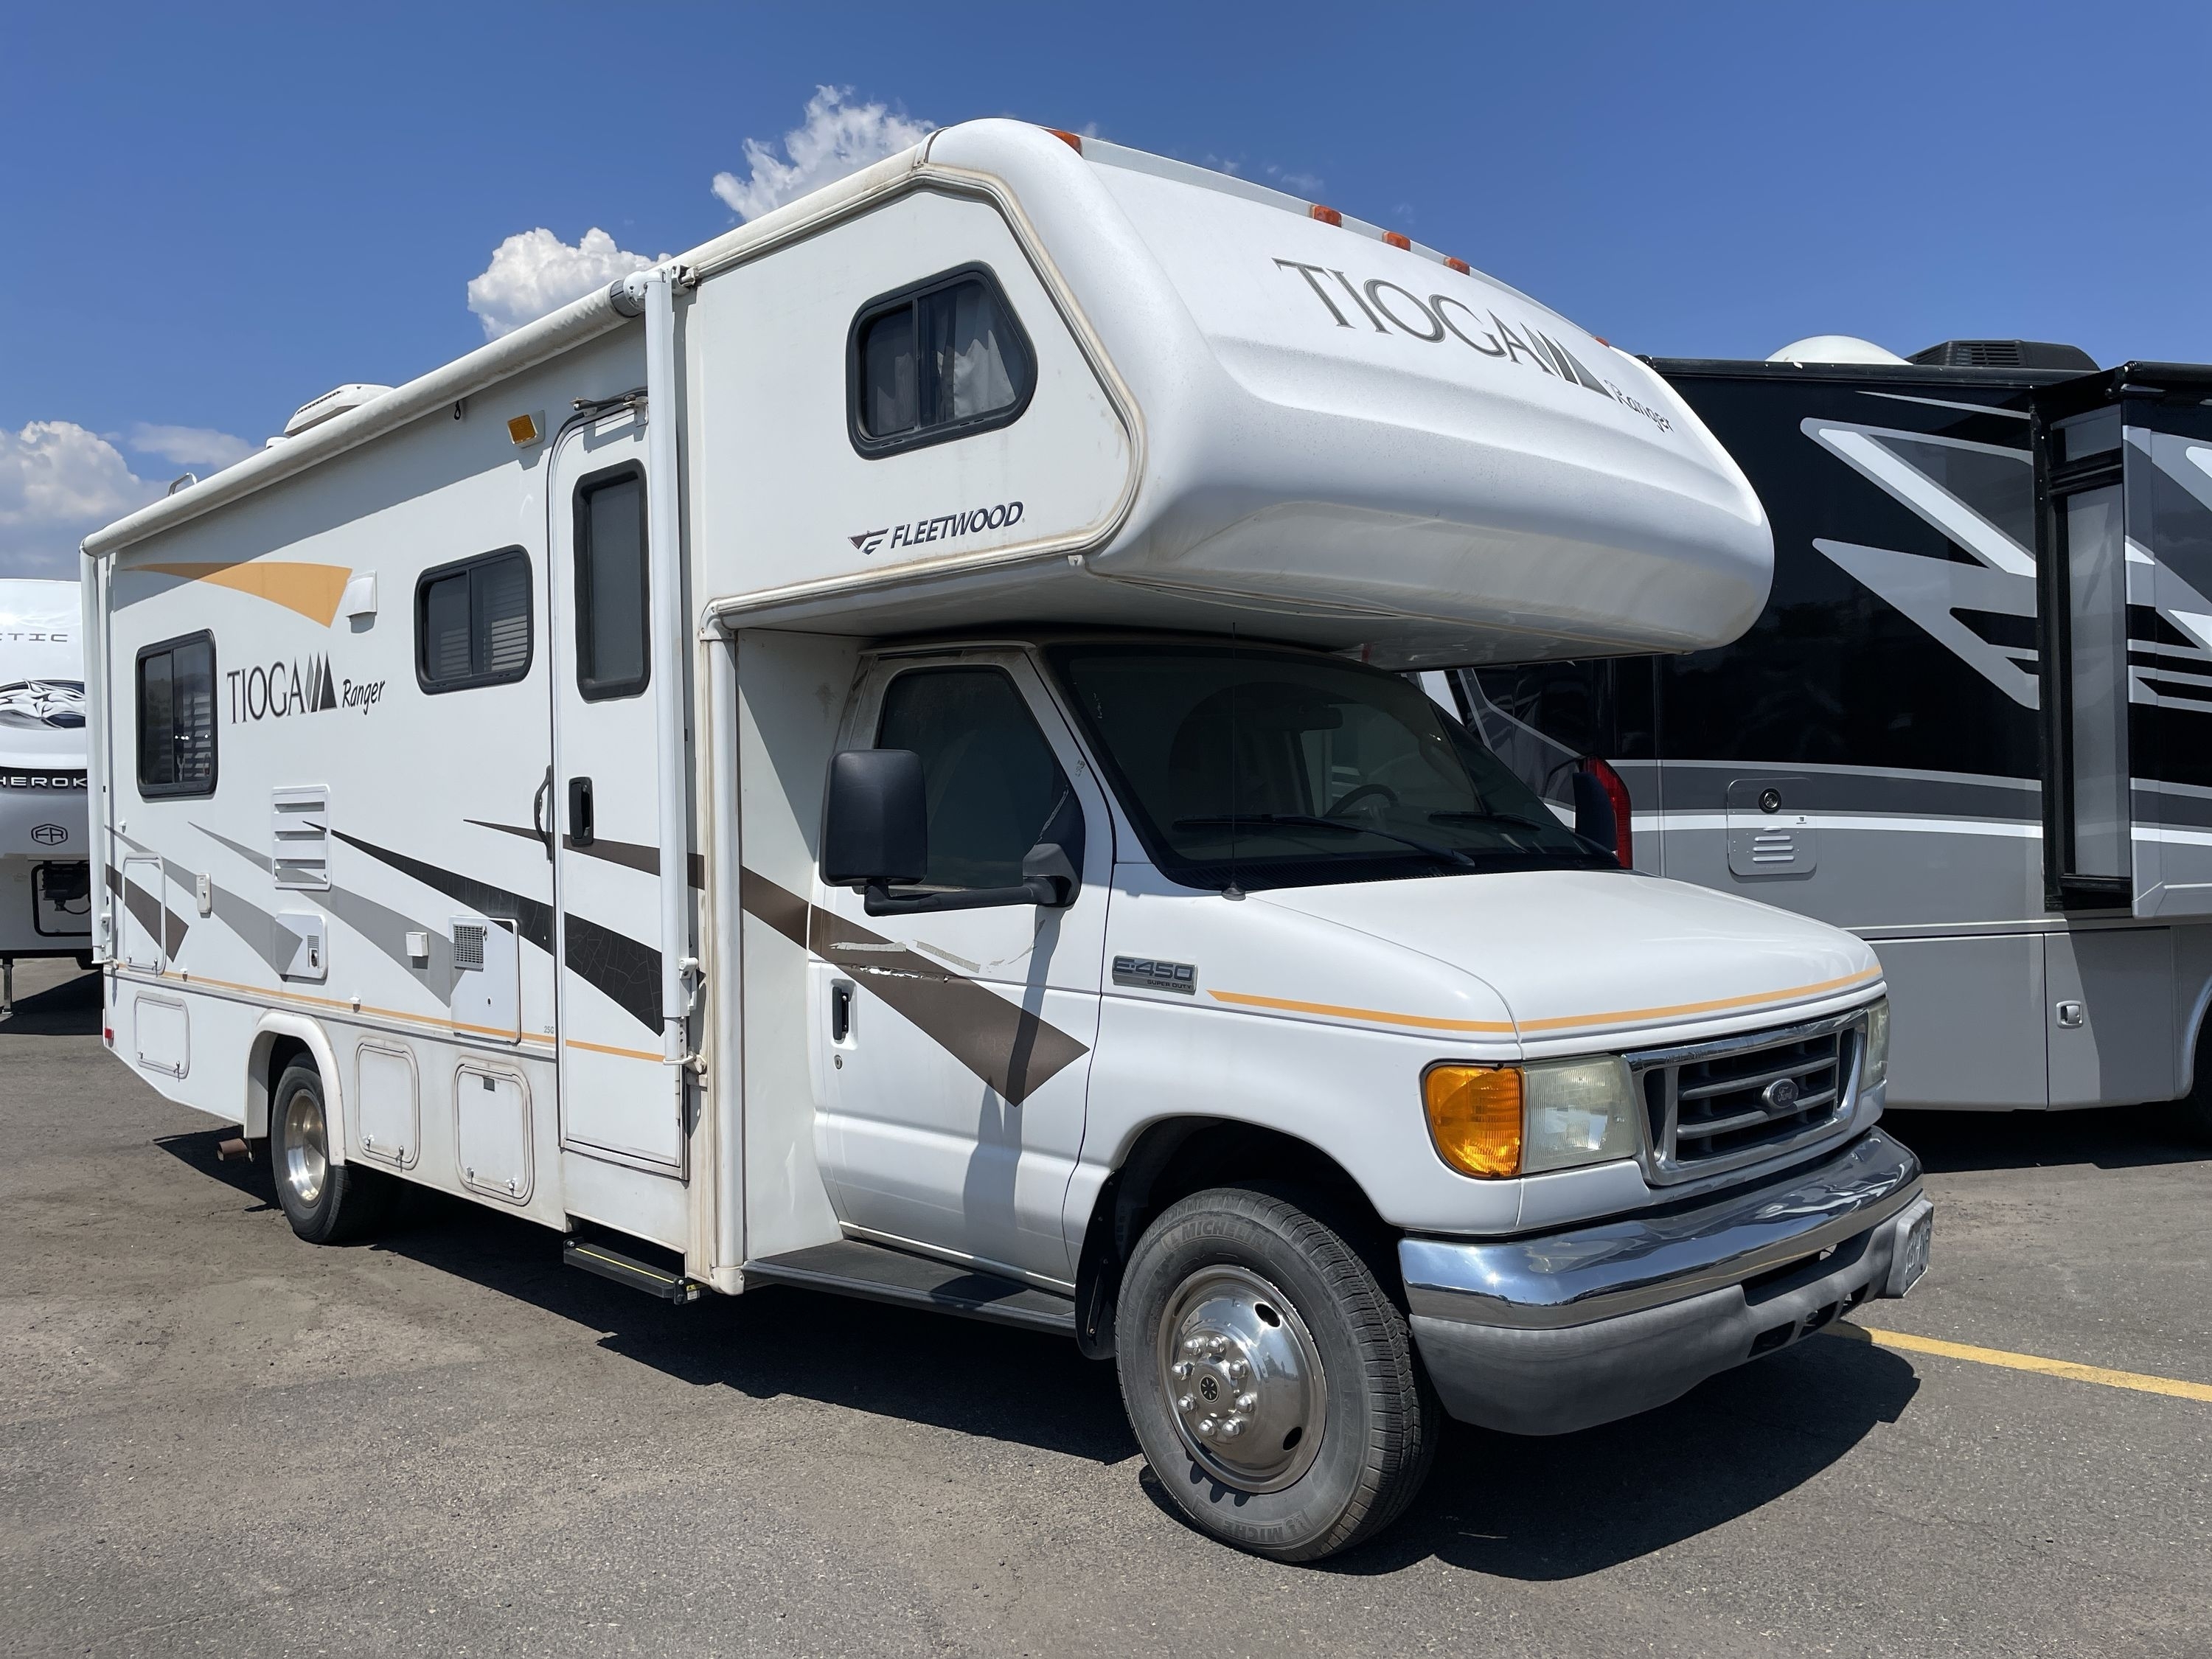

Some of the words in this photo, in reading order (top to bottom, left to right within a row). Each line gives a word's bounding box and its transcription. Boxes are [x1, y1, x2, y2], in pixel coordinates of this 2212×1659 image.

[1272, 258, 1555, 375] TIOGA
[1605, 379, 1674, 432] Ranger
[891, 501, 1023, 548] FLEETWOOD
[0, 633, 68, 642] TIC
[226, 656, 307, 724] TIOGA
[342, 678, 386, 714] Ranger
[1114, 957, 1192, 981] E-450
[543, 1025, 554, 1034] 25G
[1778, 1087, 1792, 1102] Ford
[1181, 1220, 1269, 1248] MICHELIN
